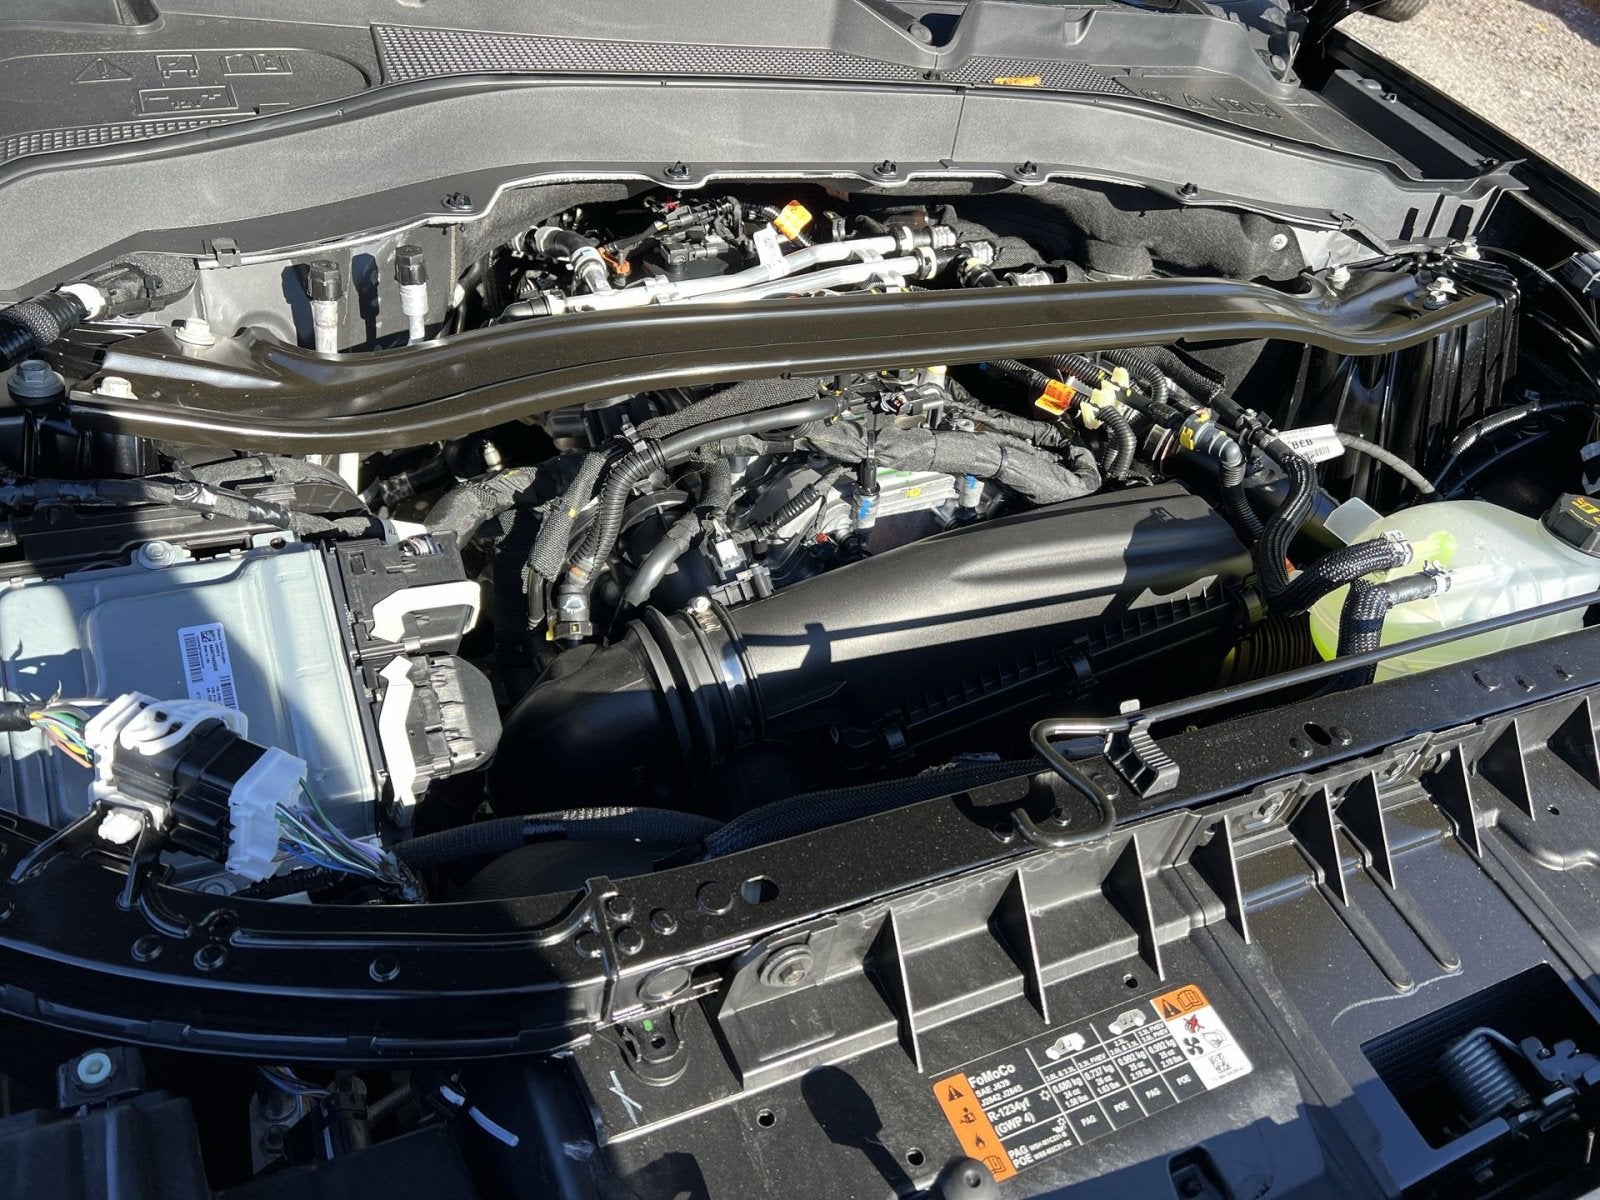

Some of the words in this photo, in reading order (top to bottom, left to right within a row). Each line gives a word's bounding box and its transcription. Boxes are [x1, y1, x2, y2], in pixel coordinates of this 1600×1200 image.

[1291, 438, 1314, 450] BEB
[1165, 1037, 1177, 1048] kg
[1134, 1049, 1147, 1061] kg
[1102, 1063, 1115, 1074] kg
[967, 1063, 1016, 1089] FoMoCo
[1070, 1075, 1083, 1087] kg
[1176, 1074, 1193, 1086] POE
[975, 1085, 992, 1098] SAE
[993, 1078, 1011, 1090] J639
[1145, 1087, 1162, 1099] PAG
[1063, 1090, 1072, 1099] 24
[987, 1097, 1031, 1123] R-1234yf
[1113, 1101, 1130, 1113] POE
[994, 1116, 1023, 1137] (GWP
[1023, 1112, 1036, 1125] 4)
[1080, 1114, 1098, 1127] PAG
[1008, 1145, 1029, 1160] PAG
[1013, 1153, 1034, 1169] POE
